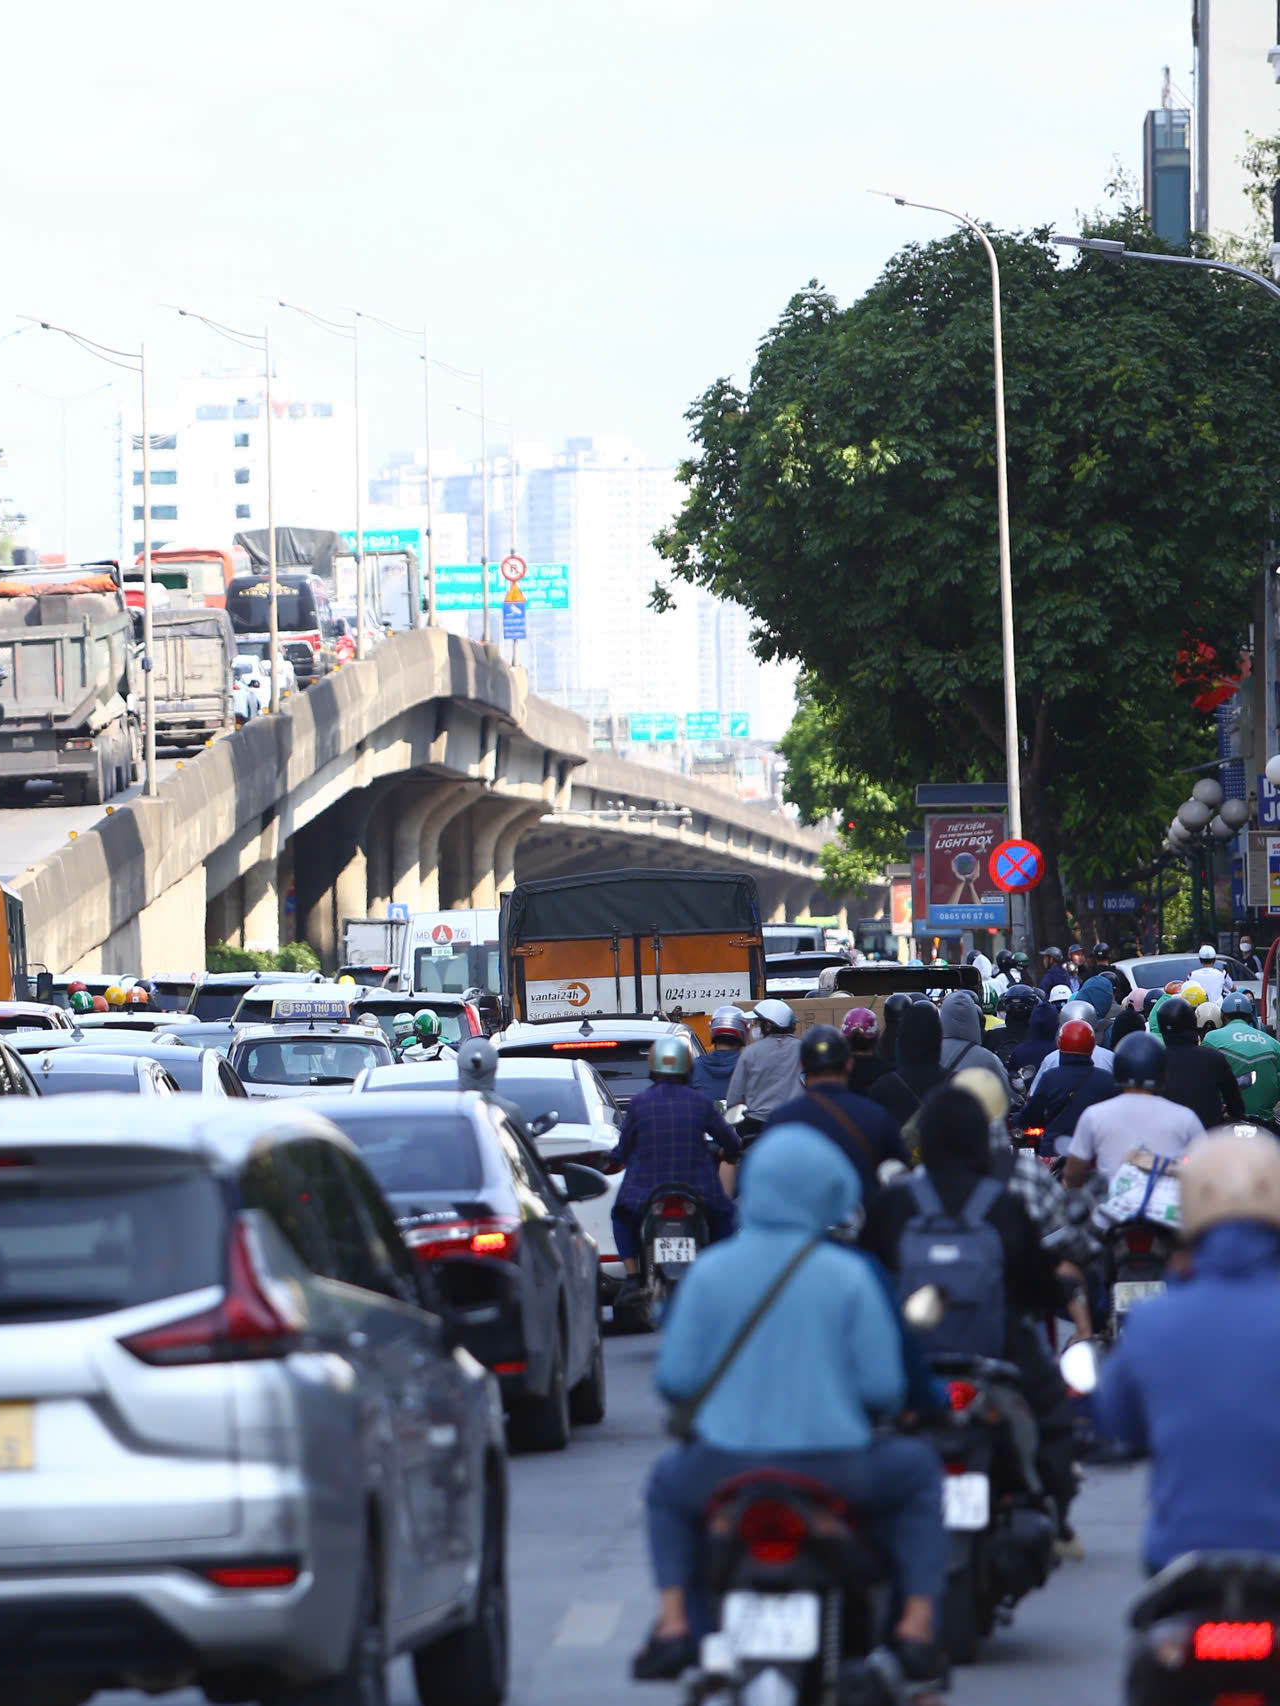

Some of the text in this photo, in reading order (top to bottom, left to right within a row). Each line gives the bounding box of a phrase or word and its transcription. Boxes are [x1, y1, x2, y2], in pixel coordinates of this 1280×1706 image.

[935, 835, 994, 849] LIGHT BOX
[531, 990, 579, 1001] vantai24h
[699, 989, 712, 998] 24
[714, 989, 726, 998] 24
[728, 988, 741, 998] 24
[295, 1003, 312, 1013] SAO
[1232, 1032, 1266, 1044] Grab
